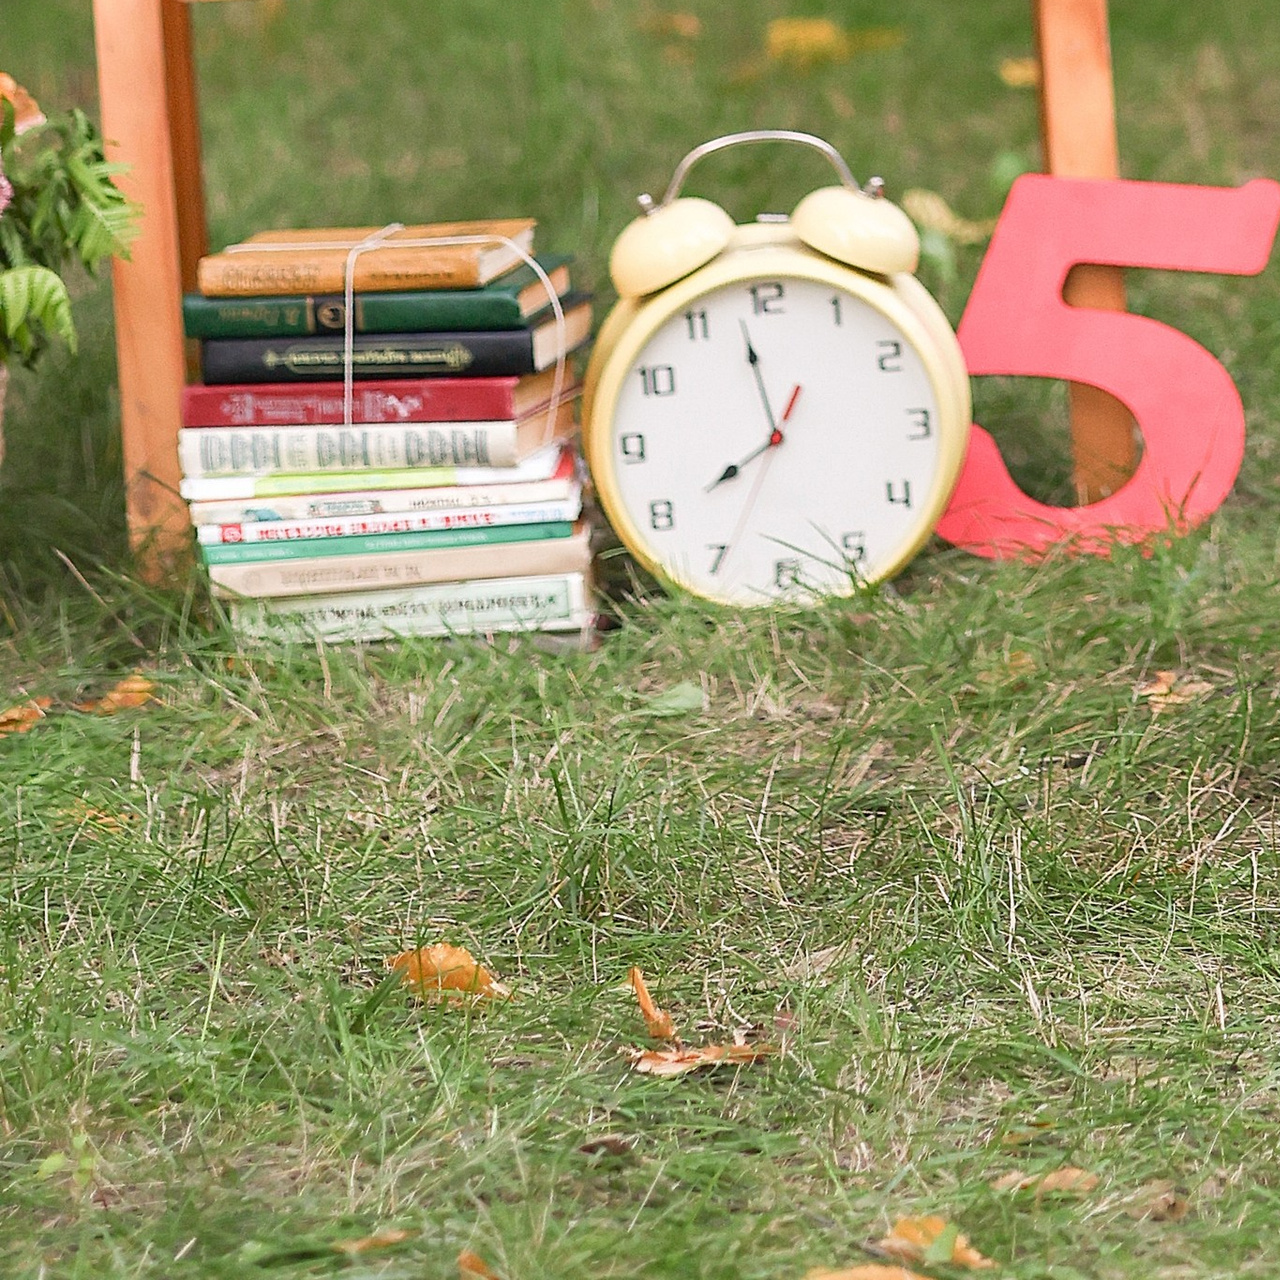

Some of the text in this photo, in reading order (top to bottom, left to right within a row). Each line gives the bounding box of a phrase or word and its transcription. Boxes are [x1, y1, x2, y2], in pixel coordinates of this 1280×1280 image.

[750, 282, 786, 316] 12
[831, 296, 842, 327] 1
[685, 308, 709, 340] 11
[877, 340, 902, 372] 2
[638, 365, 675, 397] 10
[907, 408, 932, 441] 3
[622, 433, 645, 464] 9
[886, 480, 912, 509] 4
[650, 500, 674, 530] 8
[706, 544, 729, 576] 7
[842, 531, 866, 563] 5
